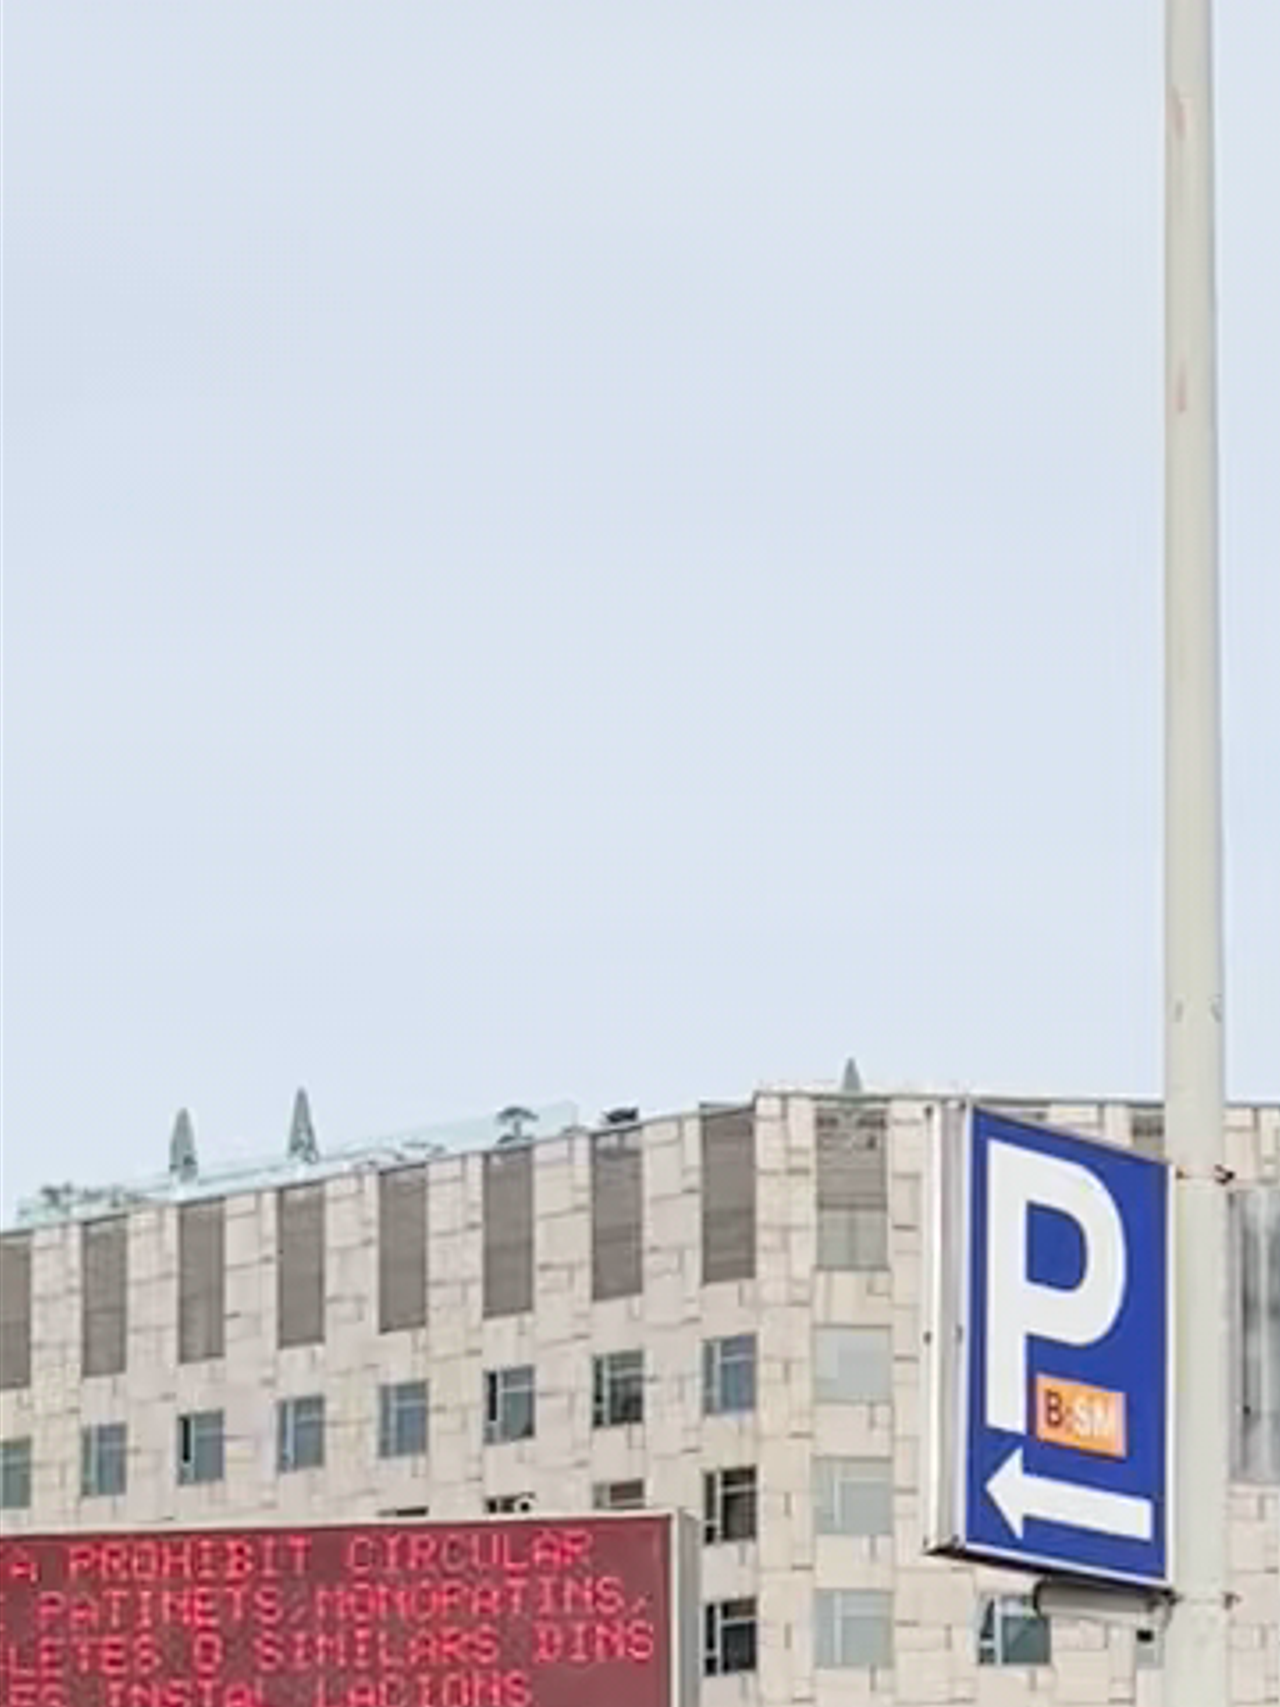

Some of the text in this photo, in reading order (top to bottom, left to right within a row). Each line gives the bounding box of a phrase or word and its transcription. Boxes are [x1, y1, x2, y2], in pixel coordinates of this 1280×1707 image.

[985, 1138, 1127, 1435] P
[68, 1535, 312, 1584] PROHIBIT
[348, 1528, 593, 1573] CIRCULAR
[254, 1622, 501, 1671] SIMILARS
